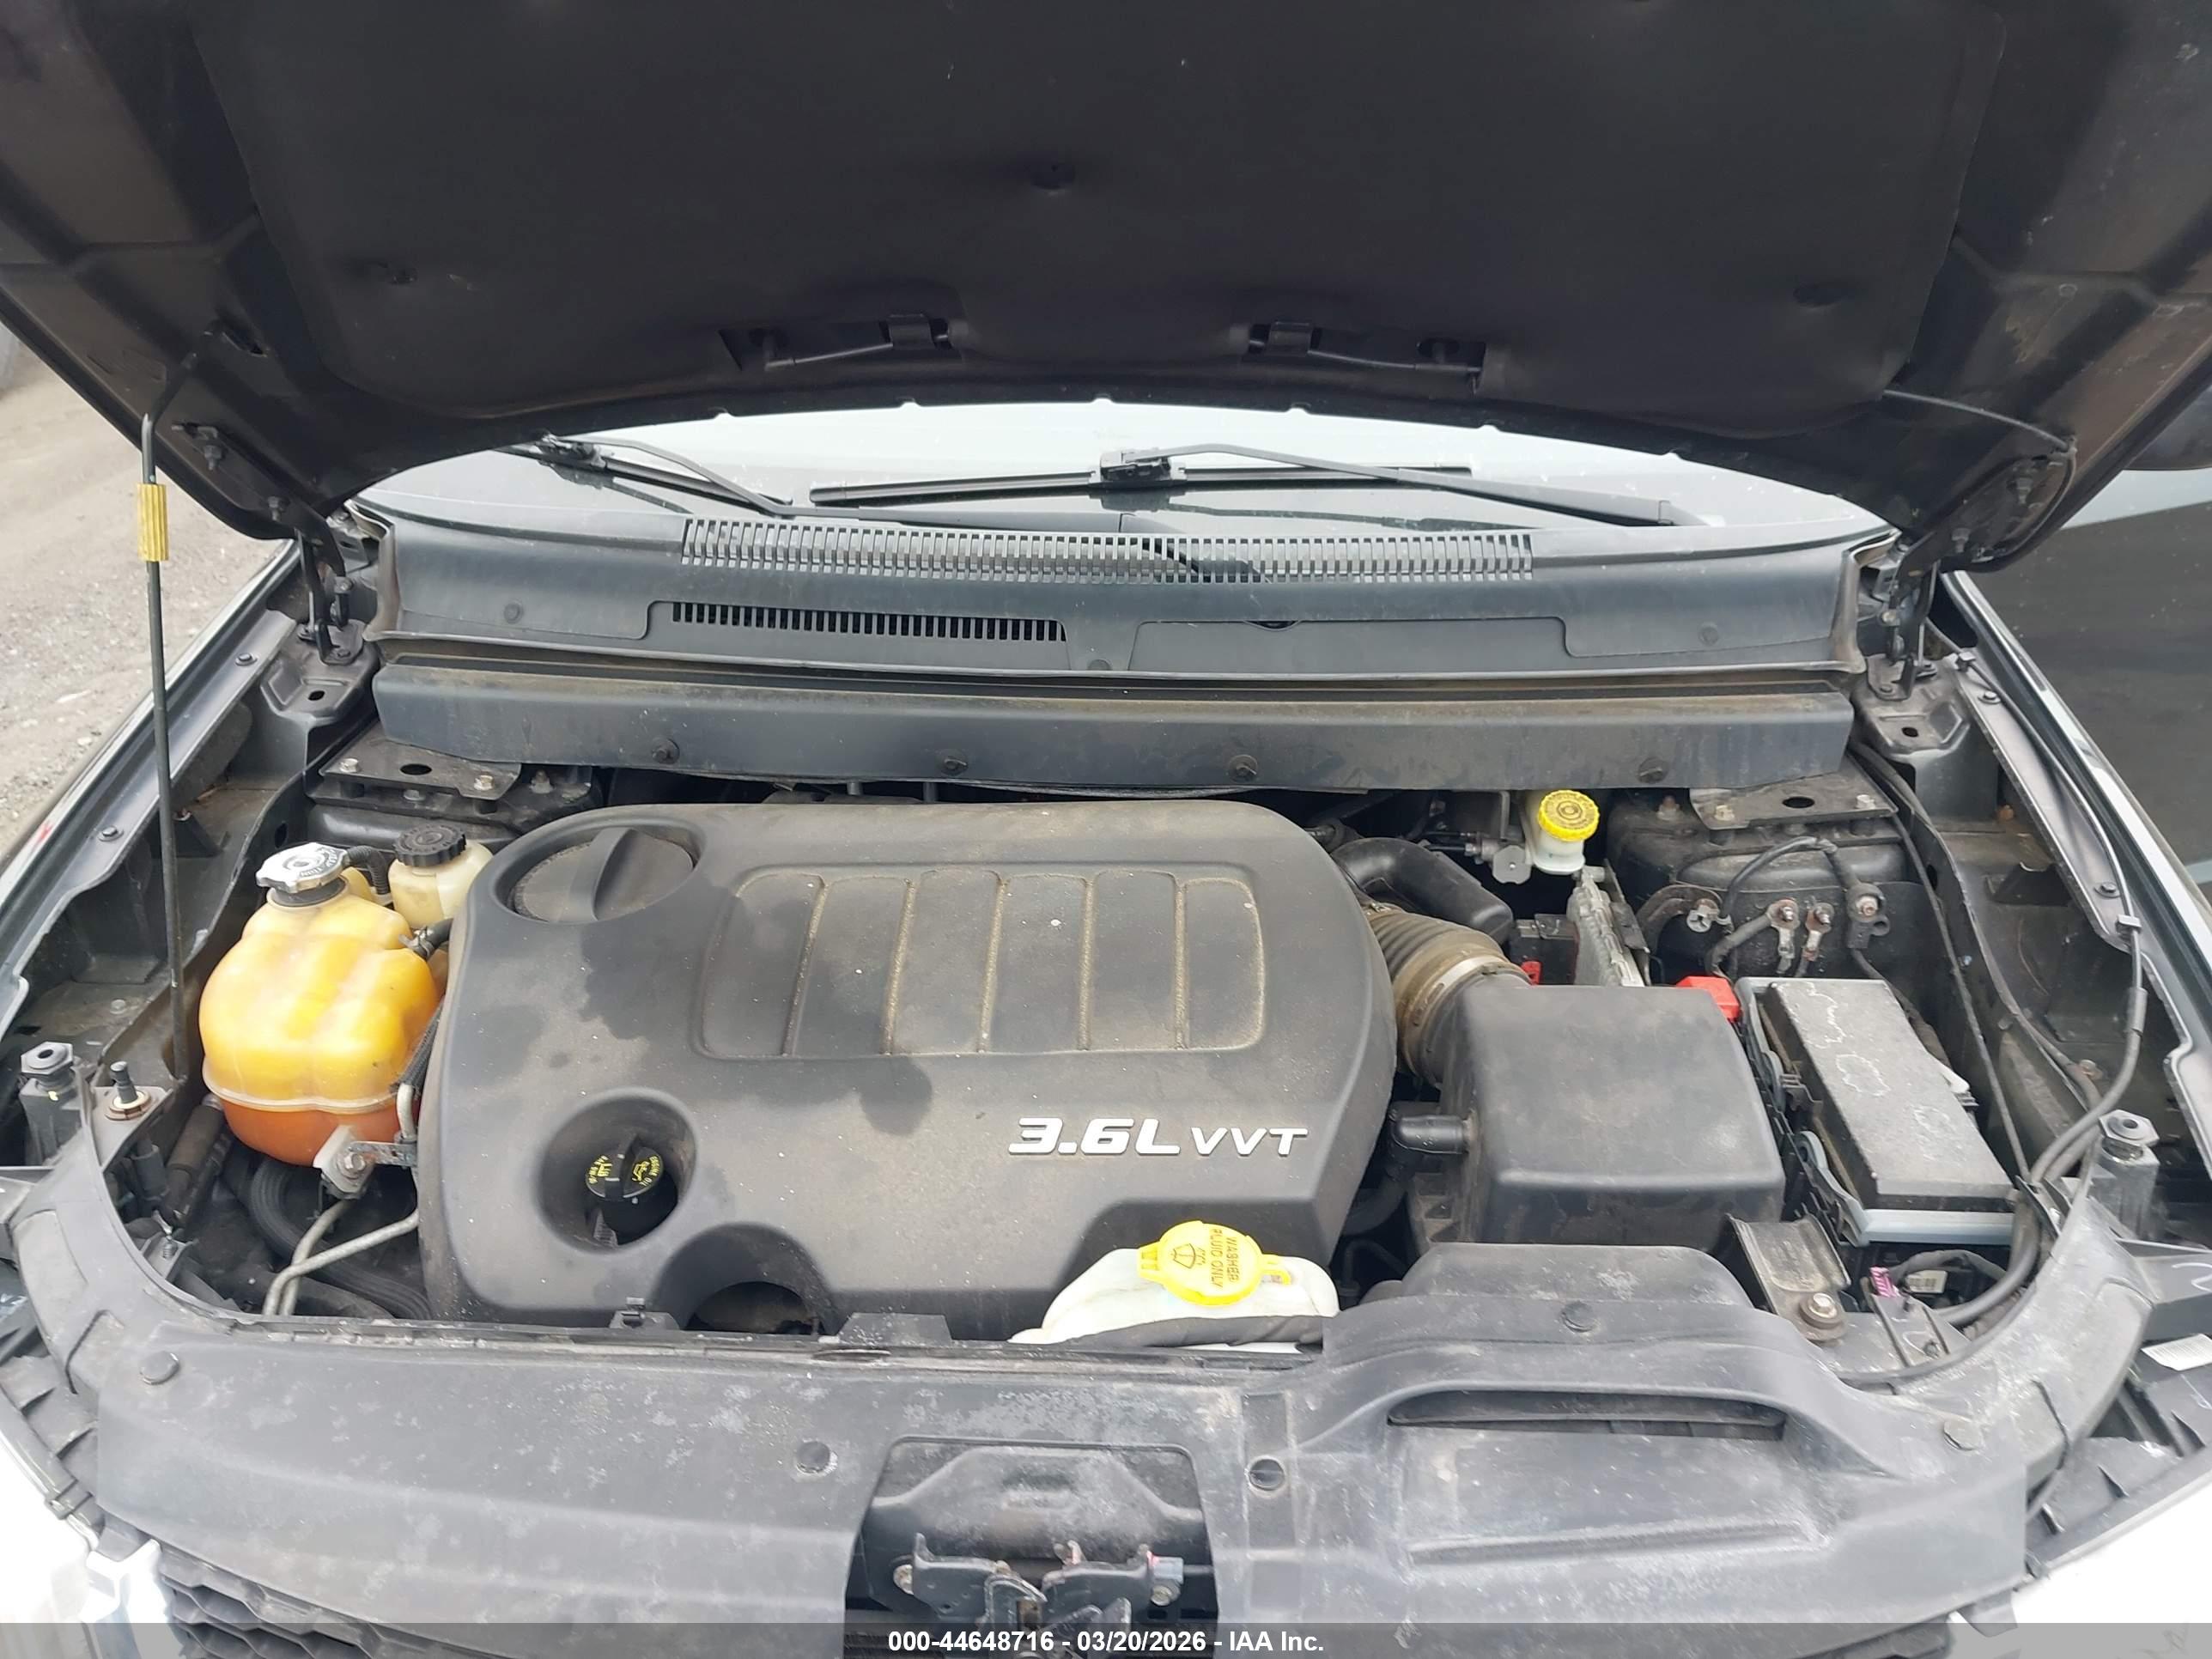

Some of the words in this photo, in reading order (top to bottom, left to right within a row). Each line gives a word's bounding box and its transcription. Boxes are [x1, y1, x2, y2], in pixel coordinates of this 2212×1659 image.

[1008, 1117, 1182, 1155] 3.6L
[1190, 1127, 1310, 1157] VVT
[1209, 1228, 1223, 1257] FLUID
[1226, 1237, 1241, 1282] WASHER
[1211, 1261, 1224, 1288] ONLY
